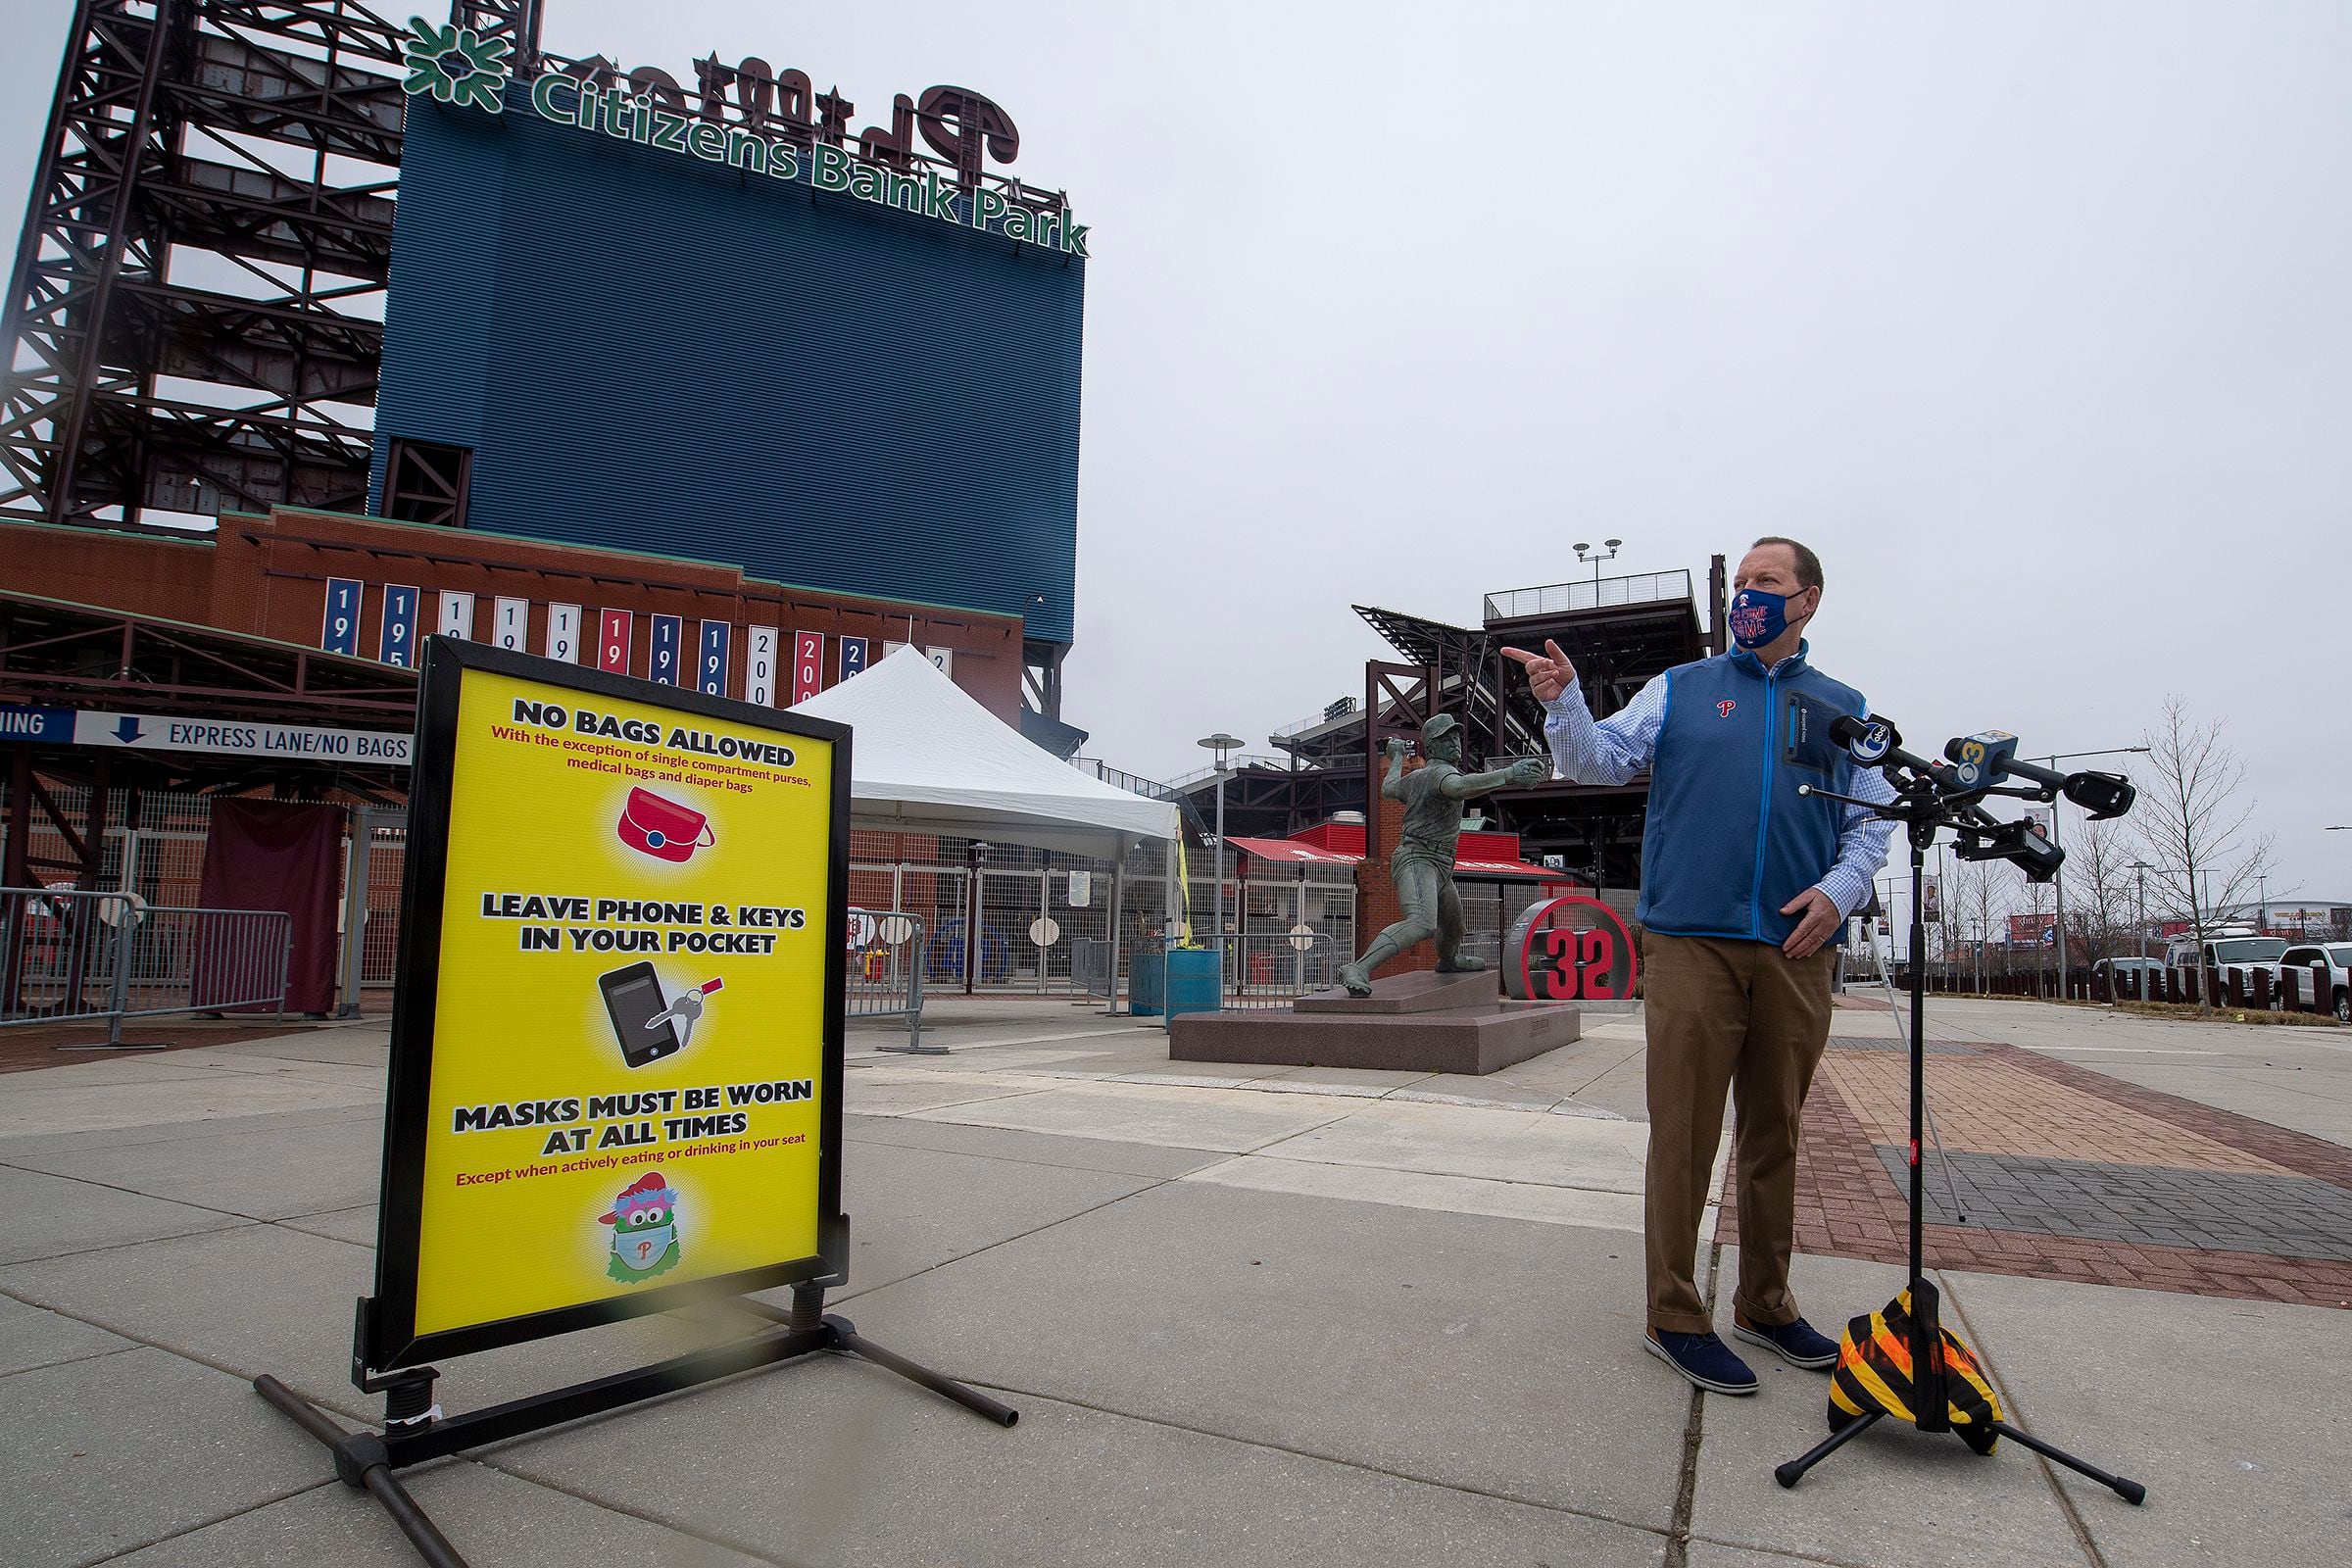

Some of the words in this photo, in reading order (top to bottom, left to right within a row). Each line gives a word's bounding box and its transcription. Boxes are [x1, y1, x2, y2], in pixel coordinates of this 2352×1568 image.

[531, 74, 798, 179] Citizens
[811, 142, 960, 224] Bank
[973, 185, 1092, 259] Park
[1717, 699, 1736, 717] P
[170, 723, 256, 750] EXPRESS
[265, 730, 349, 755] LANE/NO
[356, 737, 408, 760] BAGS
[513, 698, 567, 728] NO
[574, 710, 662, 746] BAGS
[666, 728, 796, 768] ALLOWED
[1873, 726, 1886, 743] abc
[1962, 741, 1984, 764] 3
[491, 724, 530, 744] With
[534, 733, 560, 748] the
[563, 740, 632, 761] exception
[635, 750, 650, 761] of
[652, 752, 689, 771] single
[692, 761, 770, 782] compartment
[773, 773, 811, 788] purses,
[566, 756, 621, 774] medical
[625, 763, 656, 780] bags
[659, 769, 682, 783] and
[685, 773, 724, 790] diaper
[726, 780, 754, 794] bags
[481, 893, 590, 921] LEAVE
[596, 899, 704, 925] PHONE
[710, 905, 733, 927] &
[738, 906, 806, 929] KEYS
[519, 926, 561, 952] IN
[567, 929, 661, 953] YOUR
[667, 931, 777, 956] POCKET
[1546, 928, 1614, 1000] 32
[454, 1099, 580, 1133] MASKS
[588, 1091, 677, 1120] MUST
[684, 1086, 720, 1111] BE
[727, 1079, 813, 1106] WORN
[541, 1128, 592, 1156] AT
[597, 1122, 658, 1150] ALL
[663, 1112, 748, 1141] TIMES
[456, 1168, 512, 1187] Except
[515, 1161, 558, 1178] when
[561, 1154, 618, 1172] actively
[621, 1150, 664, 1166] eating
[667, 1148, 683, 1157] or
[685, 1141, 736, 1158] drinking
[739, 1140, 751, 1151] in
[754, 1137, 780, 1152] your
[782, 1133, 807, 1147] seat
